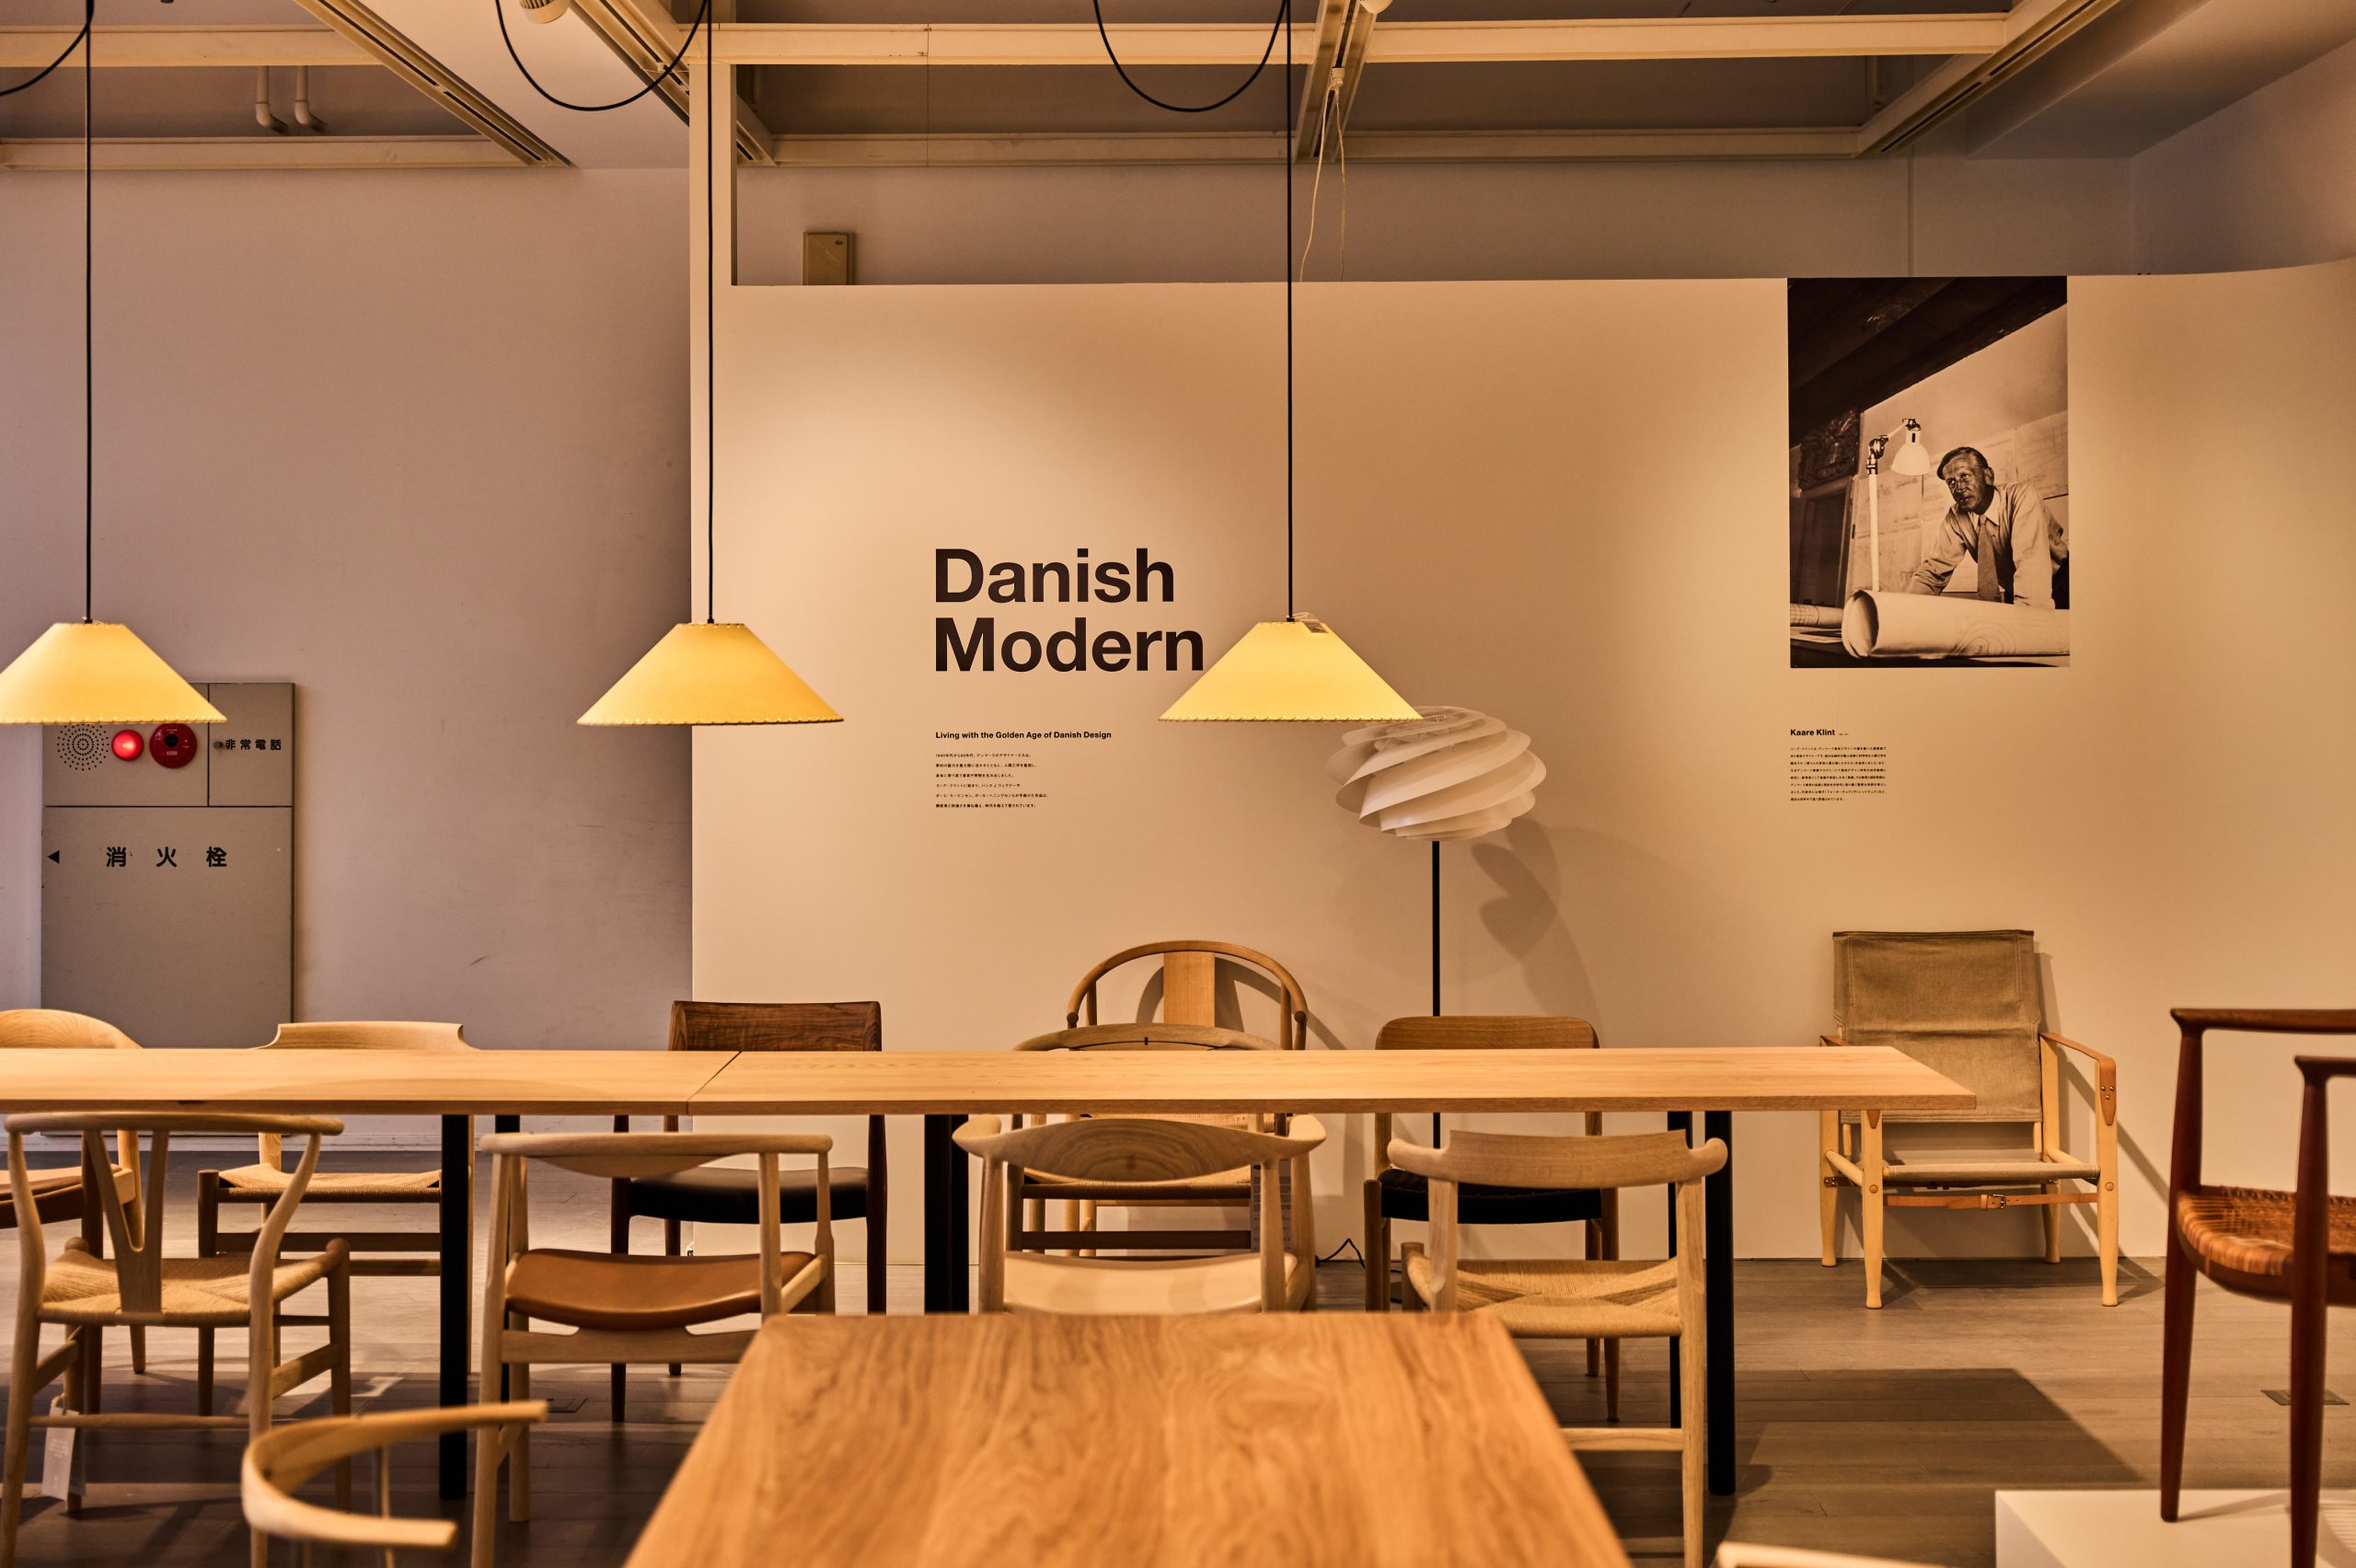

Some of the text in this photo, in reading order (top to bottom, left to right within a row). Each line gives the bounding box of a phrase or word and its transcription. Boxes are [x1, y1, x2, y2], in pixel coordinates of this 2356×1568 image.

[935, 548, 1174, 604] Danish
[935, 617, 1205, 673] Modern
[225, 738, 282, 751] 非常電話
[935, 731, 1112, 740] Living with the Golden Age of Danish Design
[105, 846, 227, 868] 消火栓
